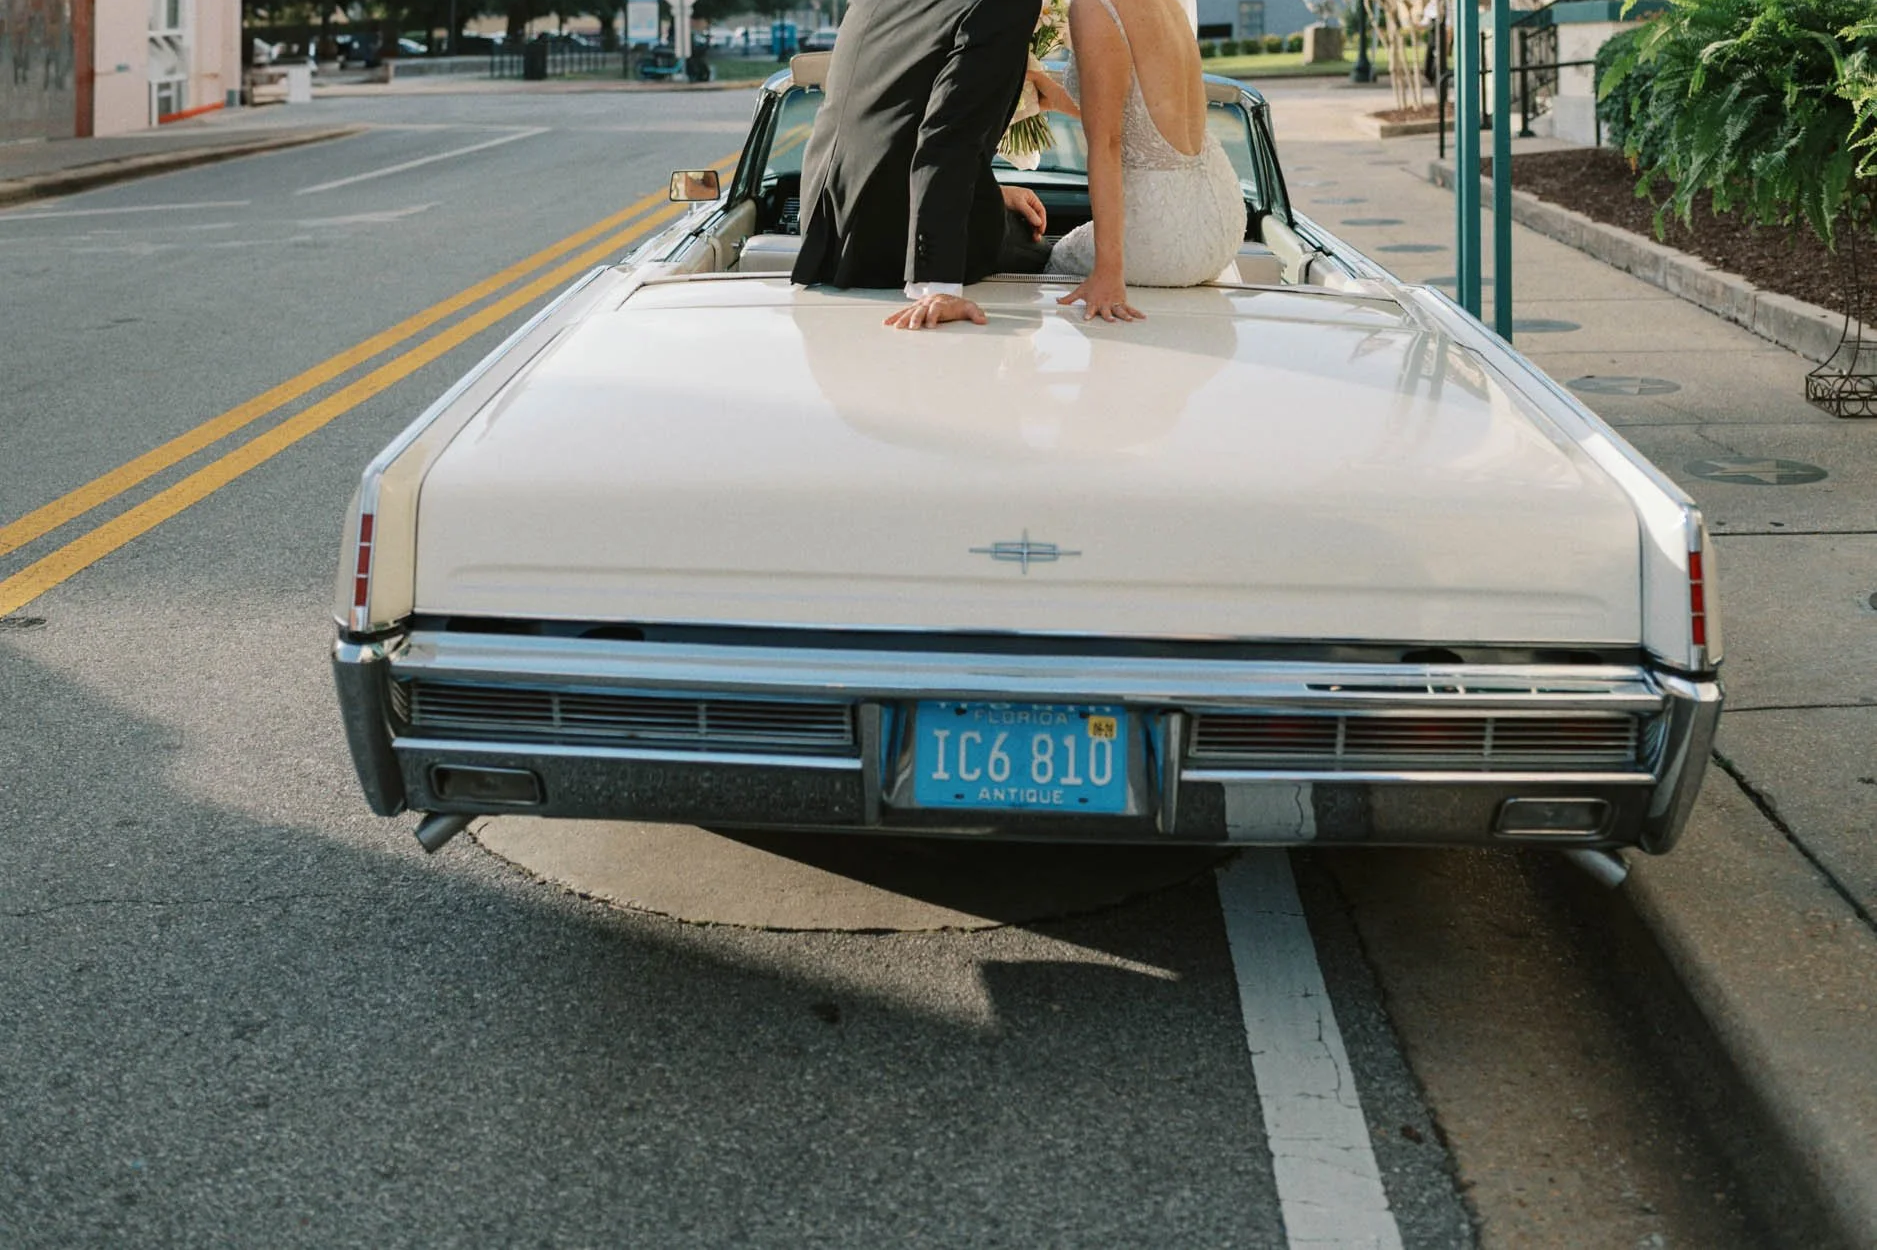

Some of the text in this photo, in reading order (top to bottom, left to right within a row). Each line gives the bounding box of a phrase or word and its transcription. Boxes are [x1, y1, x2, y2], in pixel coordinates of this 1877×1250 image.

[974, 710, 1069, 725] FLORIDA
[1031, 733, 1113, 787] 810
[978, 786, 1065, 805] ANTIQUE
